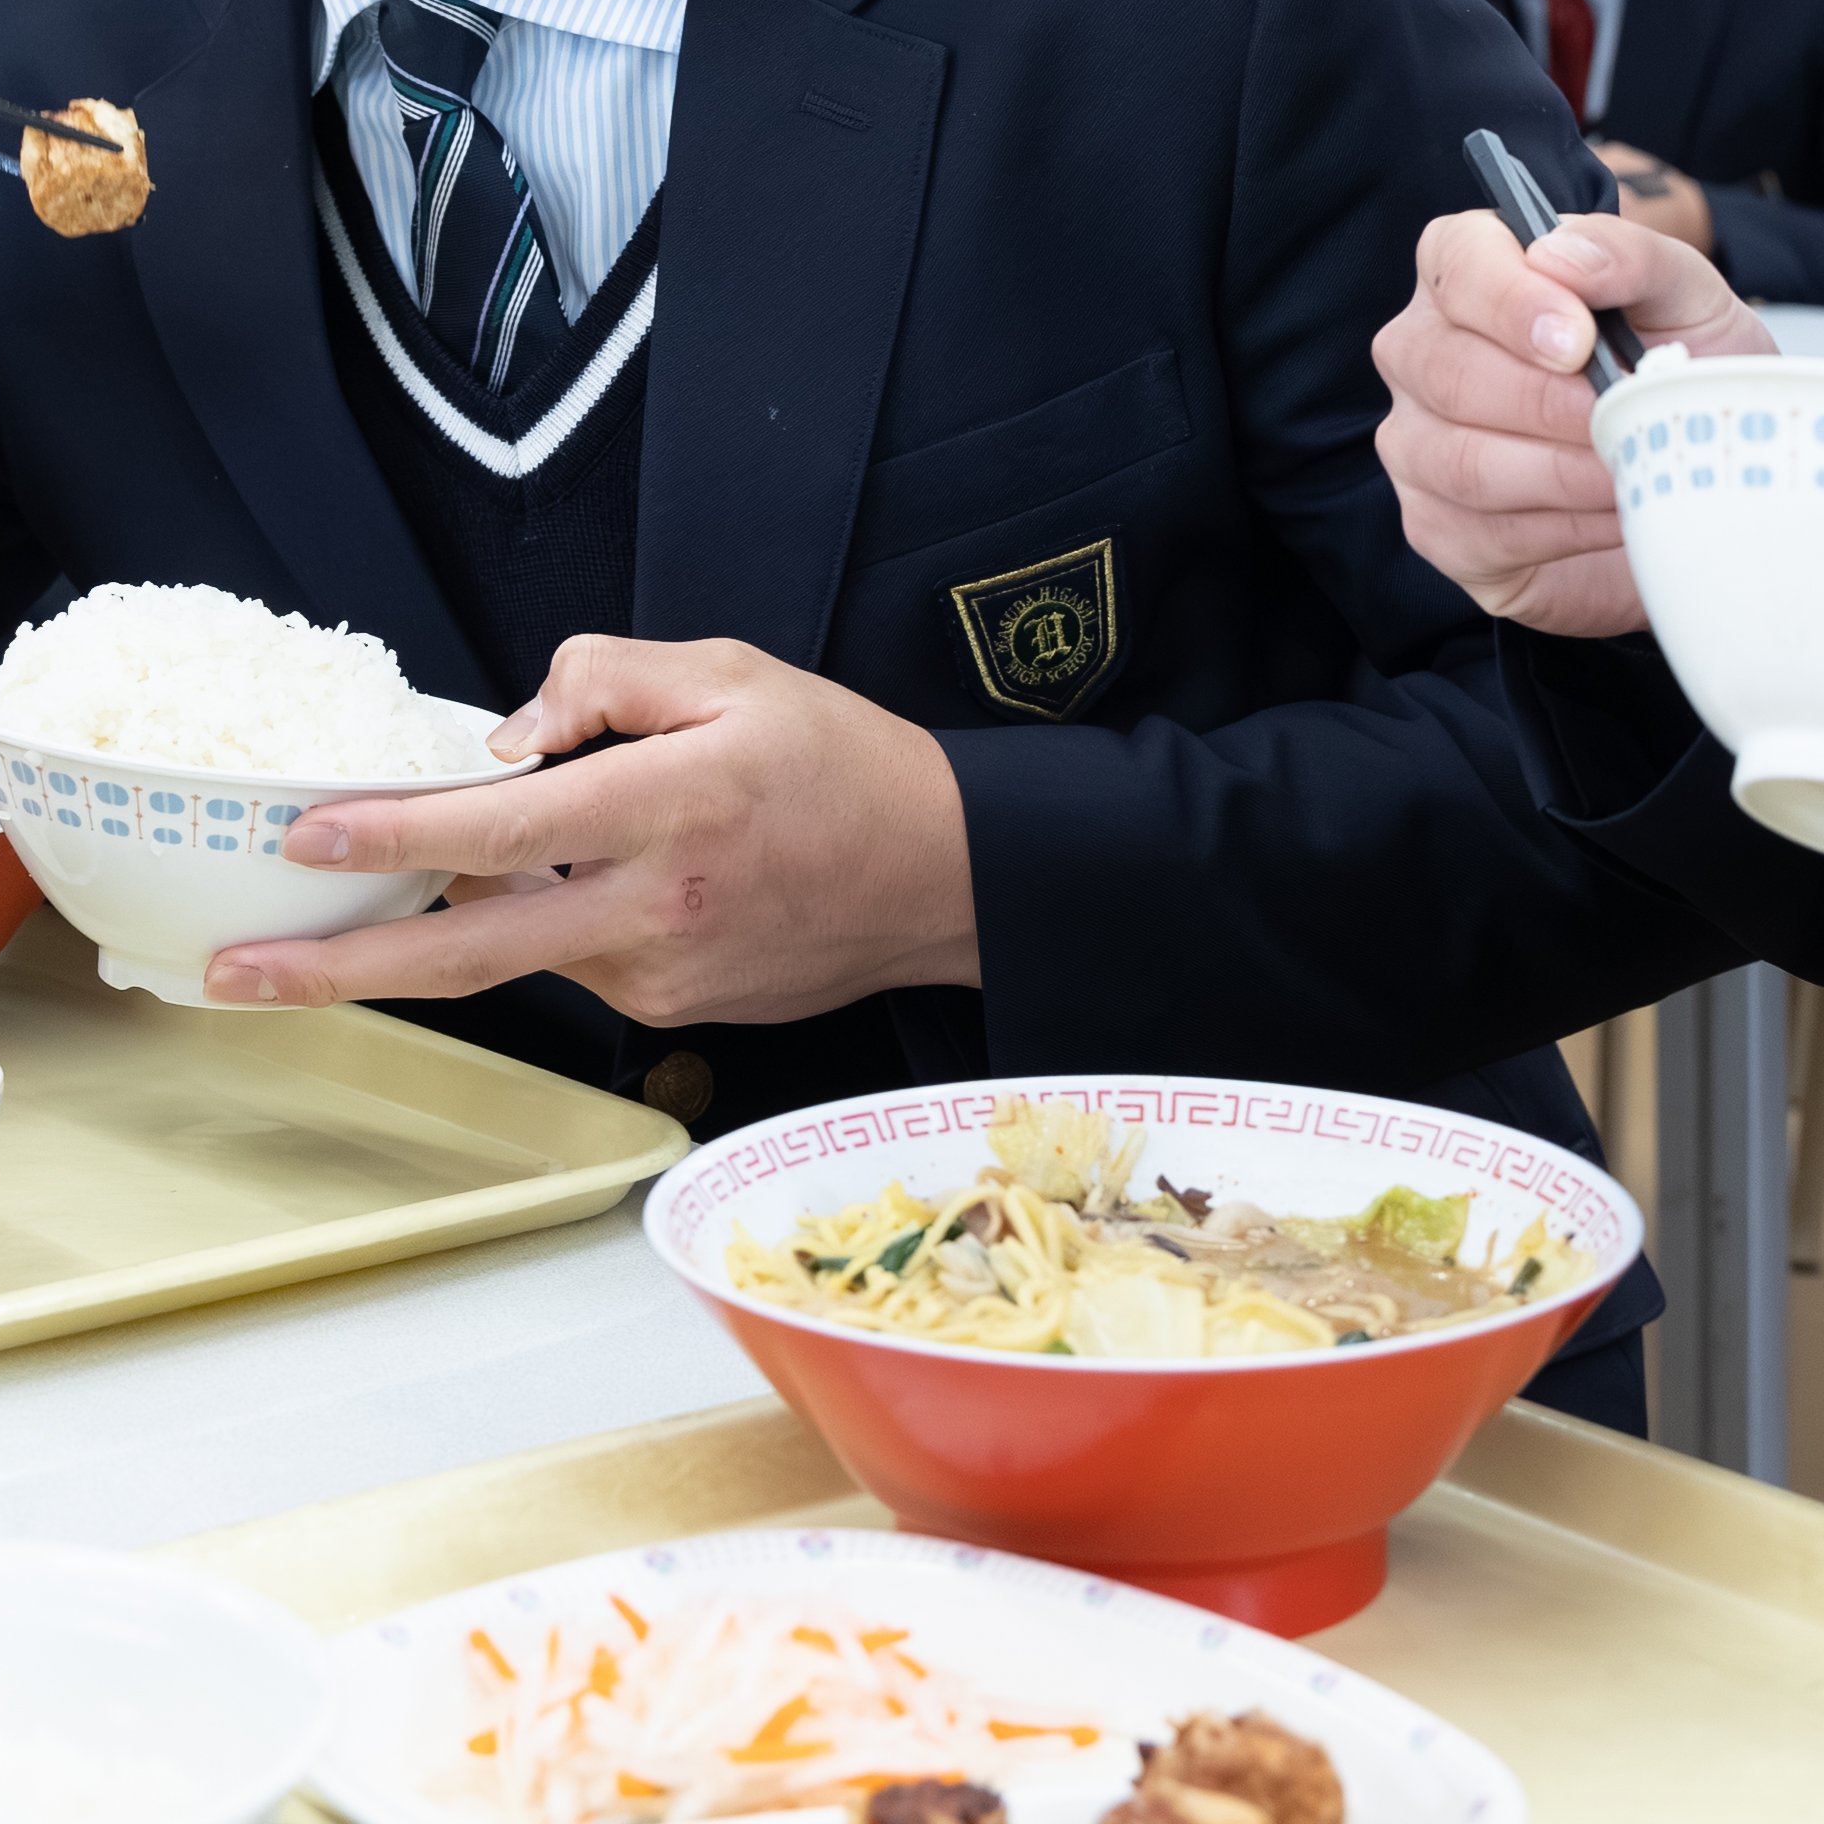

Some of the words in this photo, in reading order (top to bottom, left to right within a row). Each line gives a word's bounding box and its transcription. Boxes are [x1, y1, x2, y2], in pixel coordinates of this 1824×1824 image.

[994, 595, 1036, 654] MASUDA
[1039, 586, 1098, 626] HIGASHI
[1004, 659, 1042, 686] HIGH
[1045, 634, 1095, 684] SCHOOL
